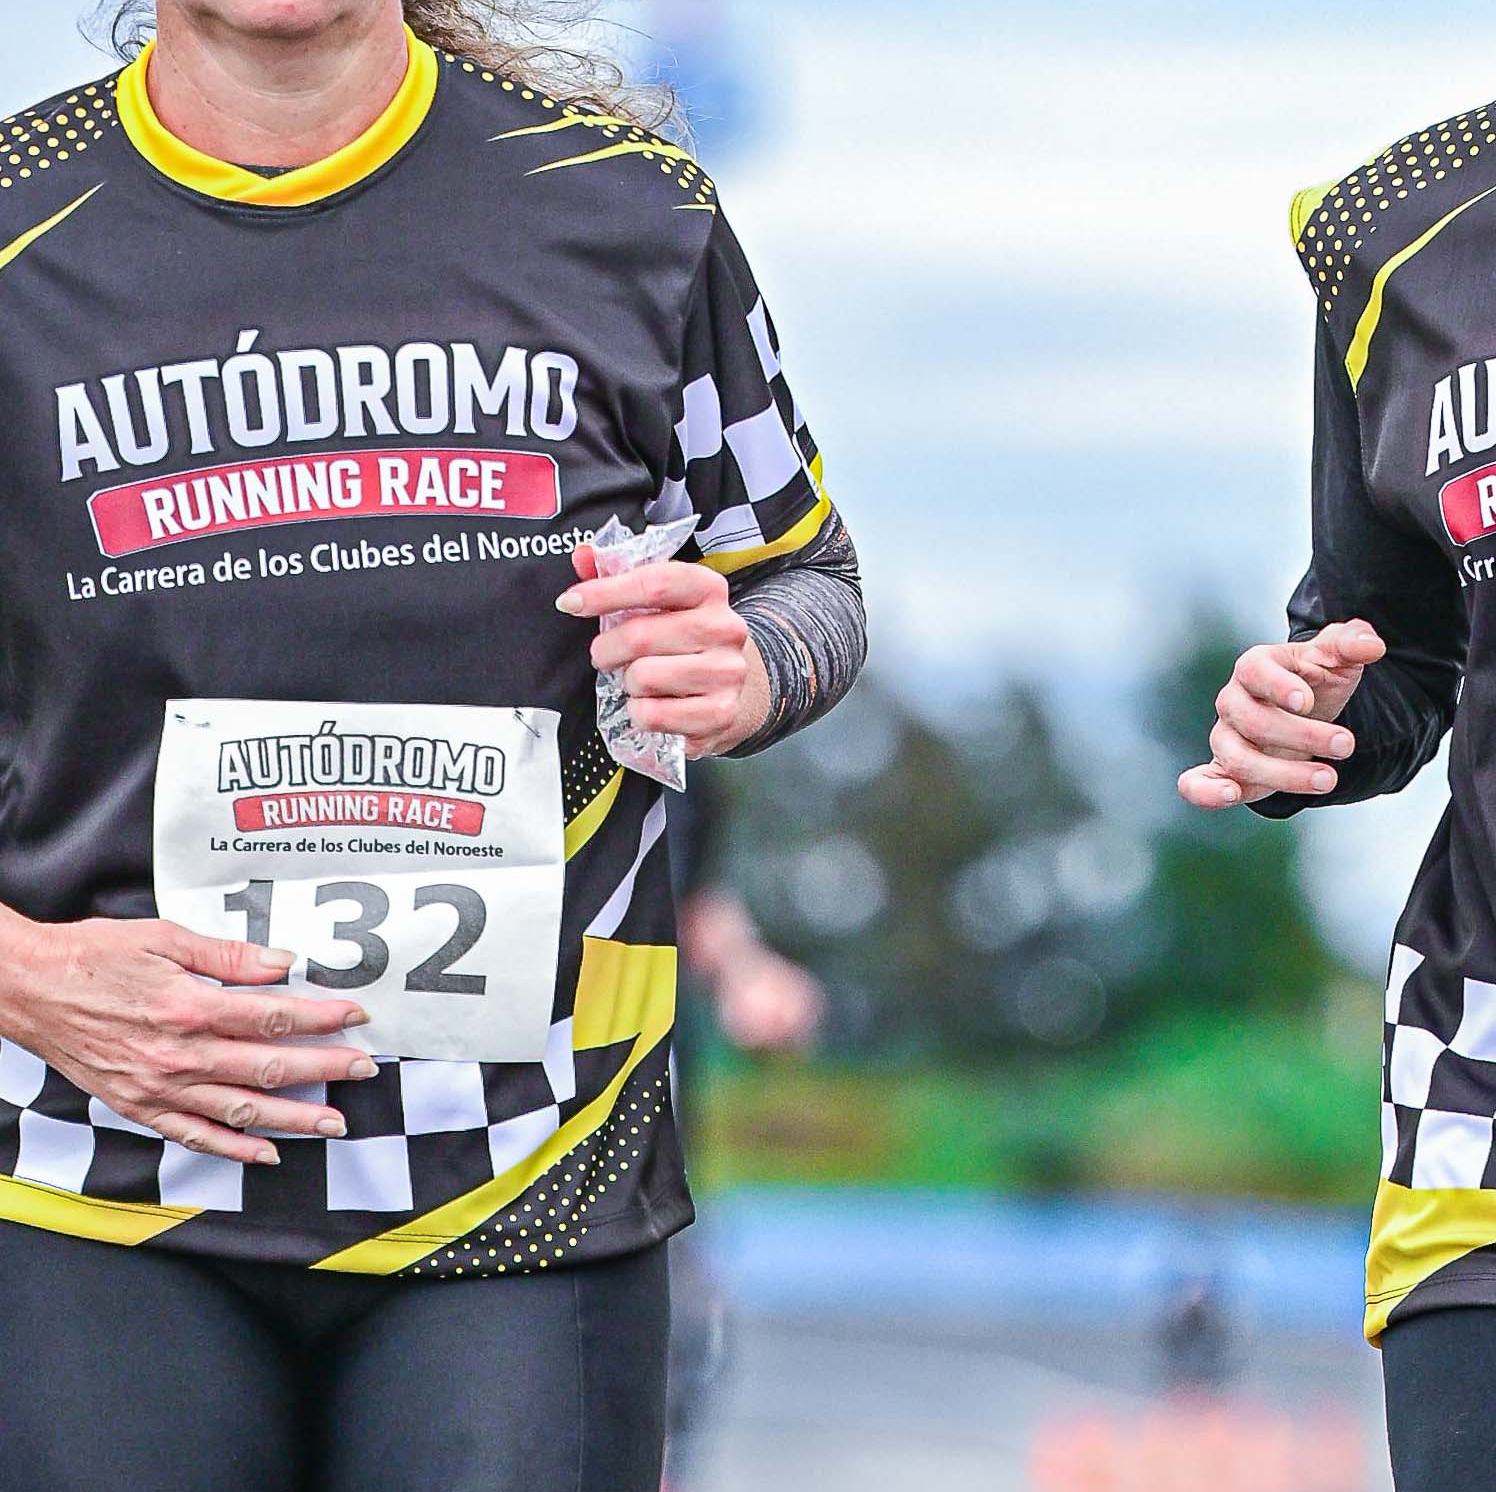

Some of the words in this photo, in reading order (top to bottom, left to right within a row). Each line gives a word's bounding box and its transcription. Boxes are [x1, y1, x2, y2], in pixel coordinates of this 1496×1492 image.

[54, 329, 580, 483] AUTÓDROMO
[140, 457, 363, 540] RUNNING
[377, 457, 507, 511] RACE
[66, 572, 97, 600] La
[100, 561, 206, 596] Carrera
[212, 551, 252, 582] de
[258, 548, 304, 578] los
[310, 539, 416, 573] Clubes
[422, 532, 470, 564] del
[217, 720, 506, 796] AUTÓDROMO
[210, 836, 228, 852] La
[232, 837, 292, 853] Carrera
[295, 837, 317, 853] de
[321, 837, 344, 853] los
[347, 838, 402, 854] Clubes
[405, 839, 430, 855] del
[433, 841, 504, 858] Noroeste
[261, 794, 379, 827] RUNNING
[387, 797, 456, 830] RACE
[222, 879, 488, 995] 132
